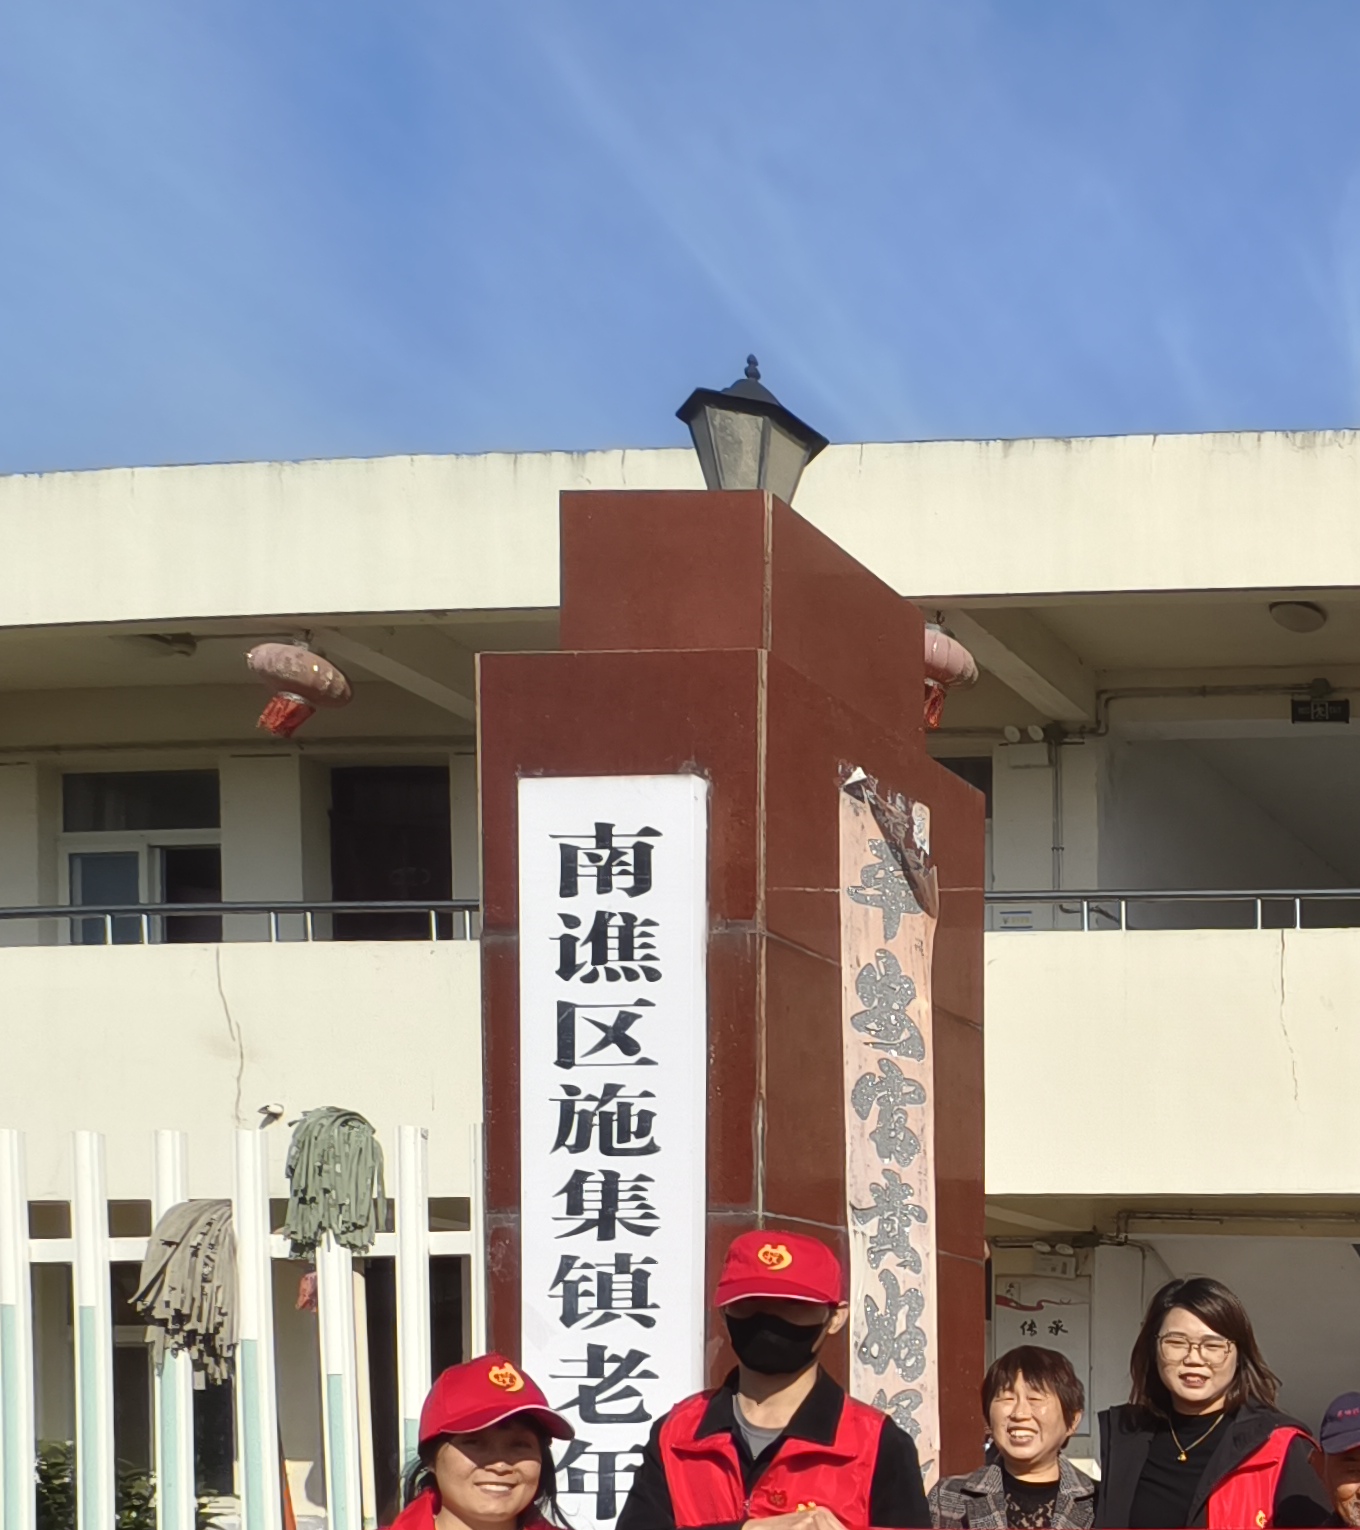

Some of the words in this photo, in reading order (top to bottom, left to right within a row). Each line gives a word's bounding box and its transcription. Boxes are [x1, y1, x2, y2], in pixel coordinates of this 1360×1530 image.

[548, 821, 661, 1522] 南谯区施集镇老年
[1019, 1319, 1069, 1337] 传承
